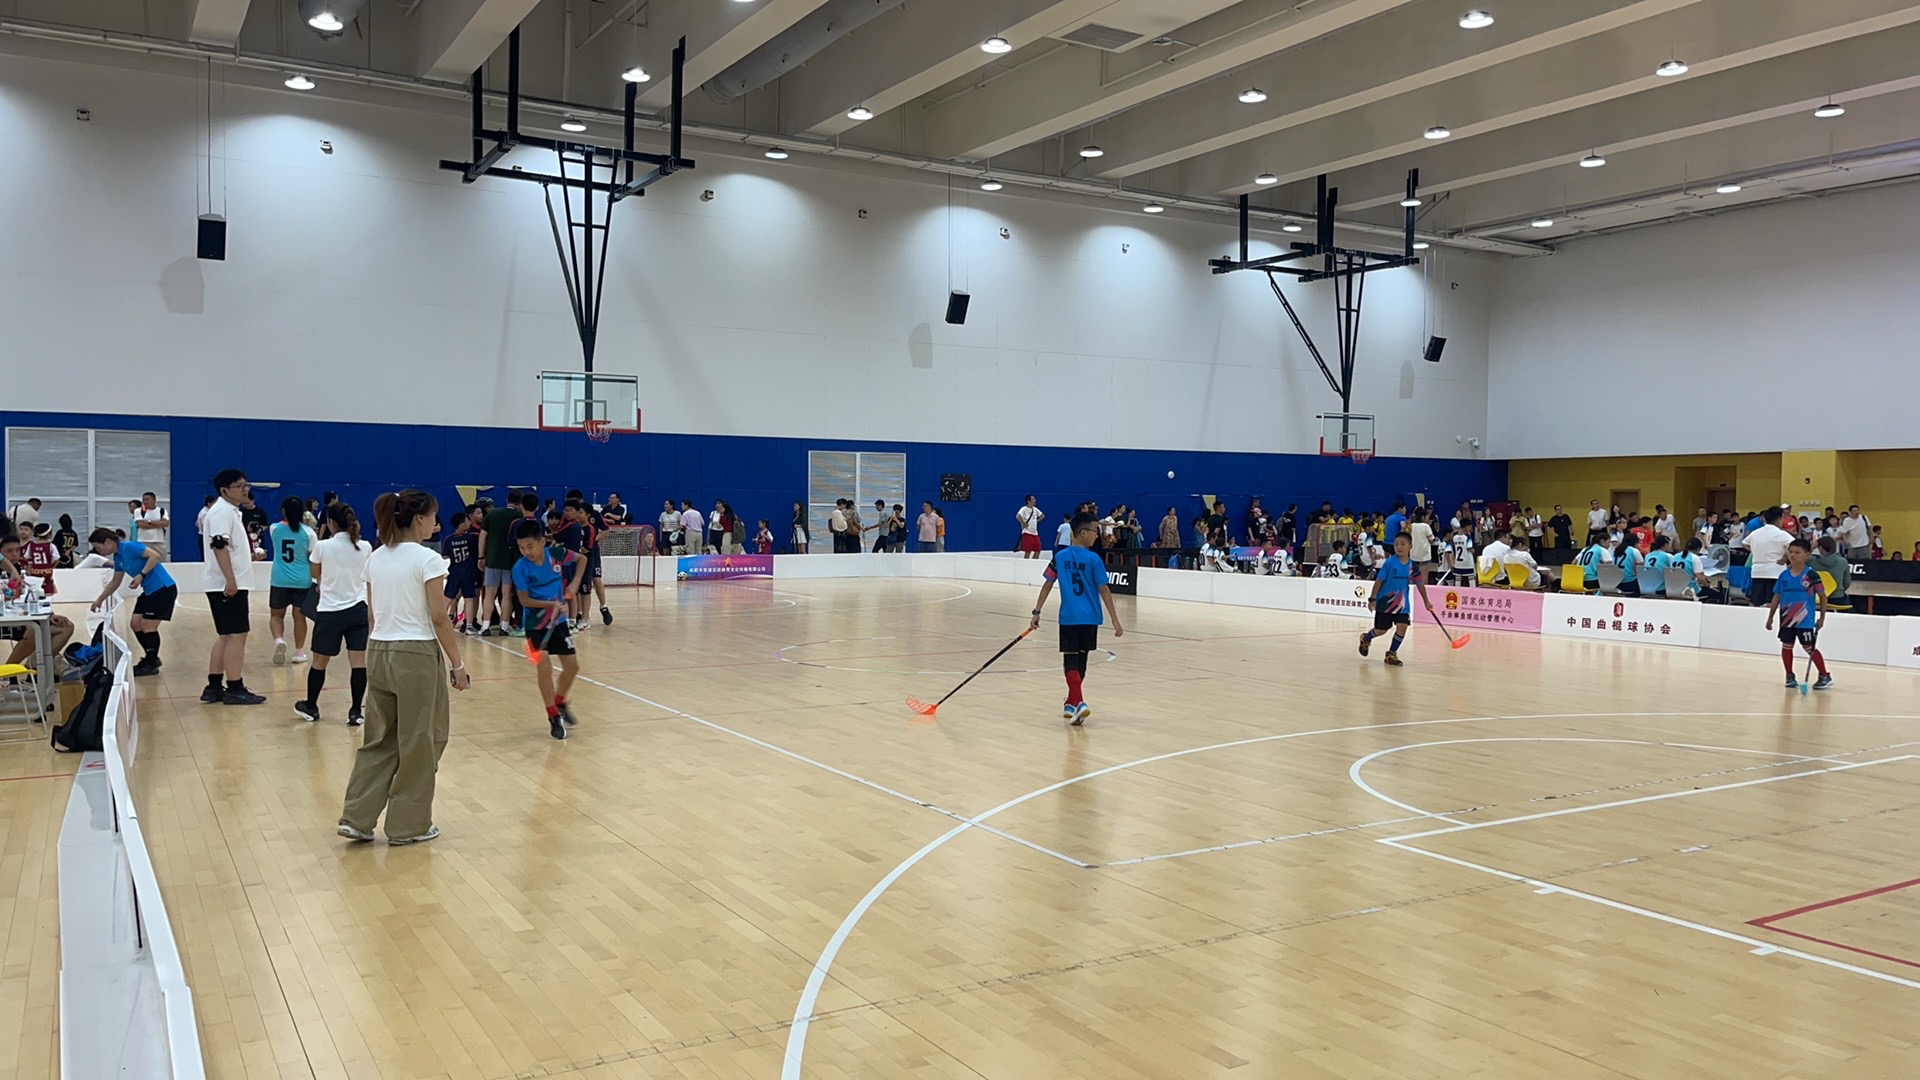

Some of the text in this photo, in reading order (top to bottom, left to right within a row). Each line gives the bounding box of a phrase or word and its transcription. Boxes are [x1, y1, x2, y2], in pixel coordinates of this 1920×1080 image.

[62, 535, 75, 548] 10
[281, 539, 295, 563] 5
[33, 552, 48, 565] 21
[1579, 551, 1594, 566] 10
[1072, 572, 1084, 597] 5
[1461, 595, 1512, 609] 国家体育总局
[1566, 616, 1671, 635] 中国曲棍球协会
[1802, 631, 1812, 642] 11
